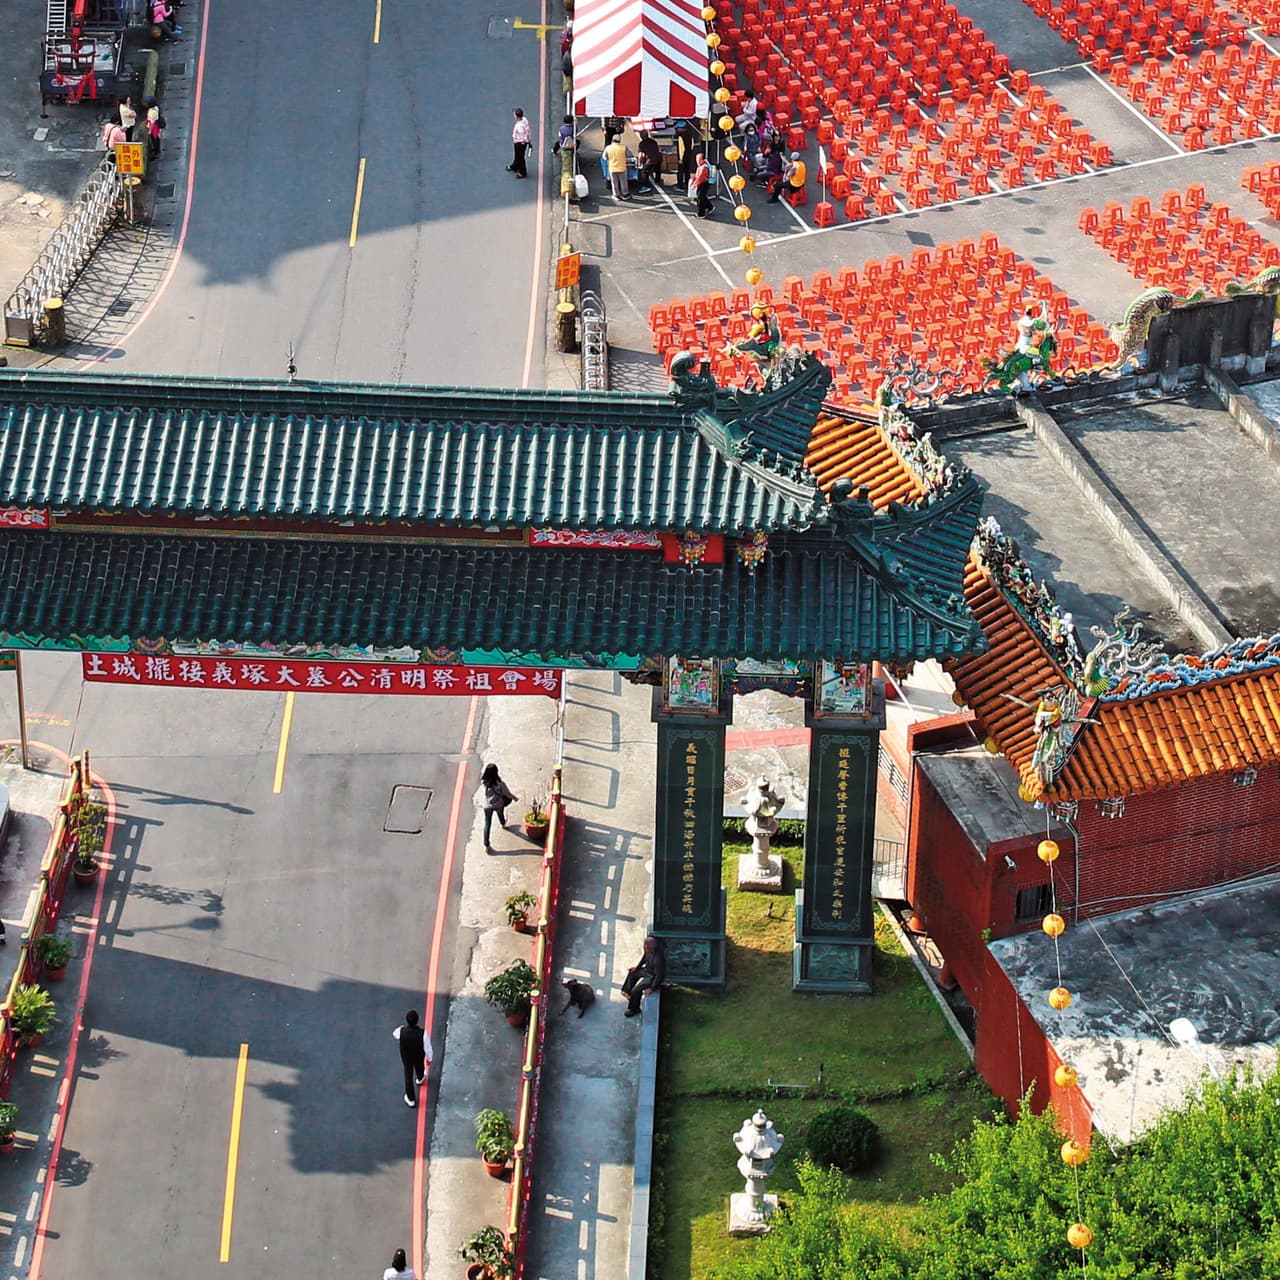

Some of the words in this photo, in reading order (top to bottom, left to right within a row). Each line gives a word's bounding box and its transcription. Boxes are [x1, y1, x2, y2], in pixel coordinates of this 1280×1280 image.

[87, 654, 559, 691] 土城擺接義塚大墓公清明祭祖會場
